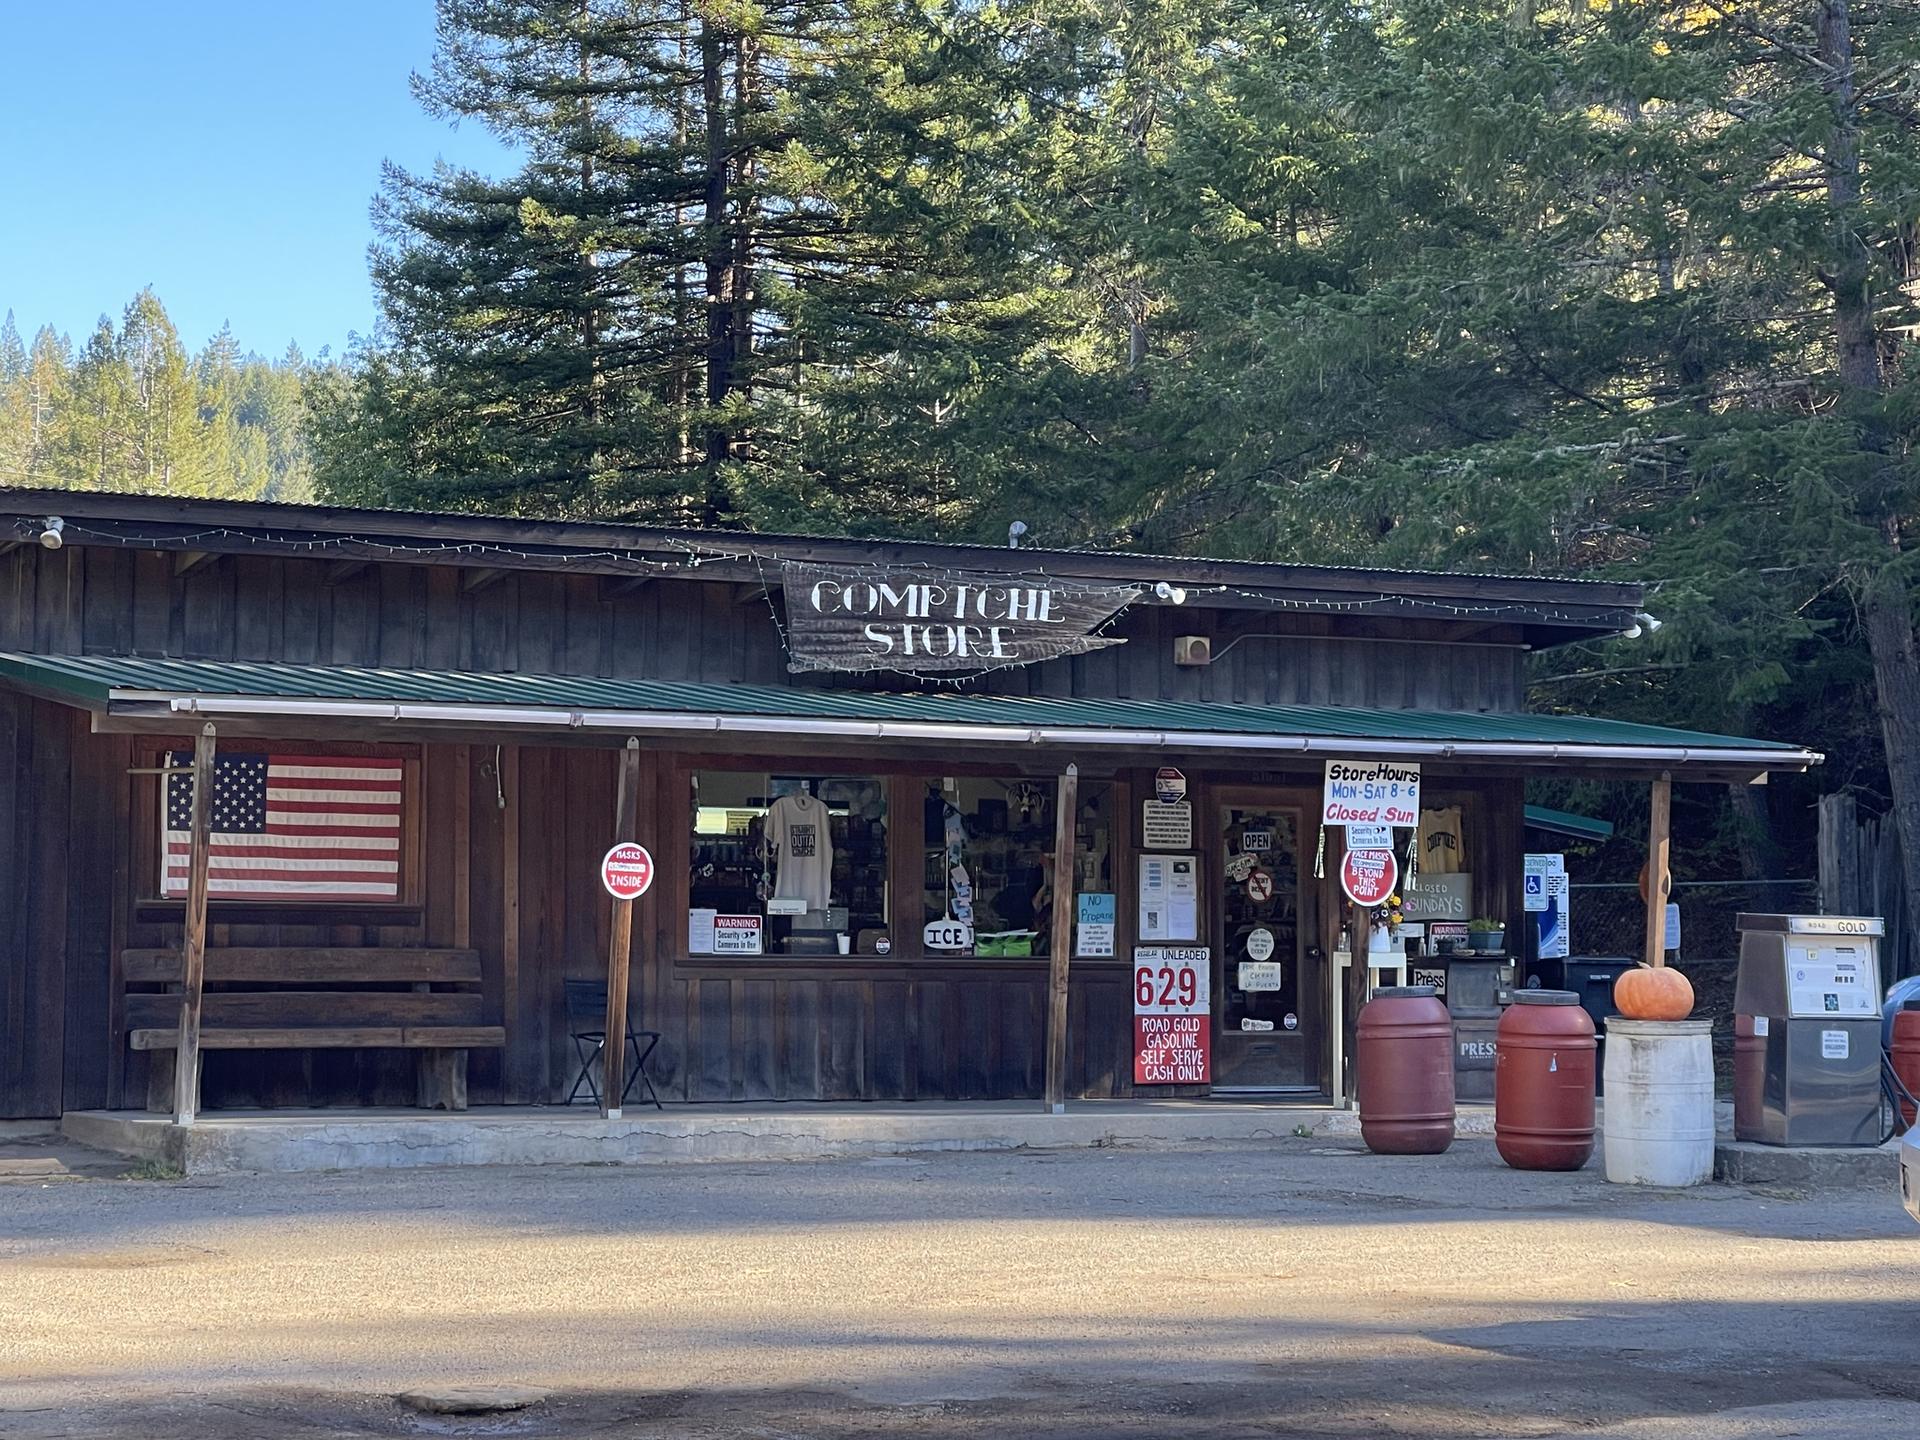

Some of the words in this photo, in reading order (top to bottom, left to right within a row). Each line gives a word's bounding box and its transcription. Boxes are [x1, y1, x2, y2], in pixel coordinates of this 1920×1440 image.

[811, 580, 1065, 623] COMPTCHE
[864, 623, 1020, 659] STORE
[1329, 764, 1377, 781] Store
[1375, 763, 1420, 783] Hours
[1326, 803, 1380, 822] Closed
[1384, 807, 1415, 823] Sun
[1351, 826, 1372, 836] Security
[791, 835, 815, 847] OUTTA
[1245, 834, 1269, 848] OPEN
[616, 850, 641, 860] MASKS
[1369, 851, 1390, 861] MASKS
[1352, 867, 1384, 879] BEYOND
[610, 875, 643, 888] INSIDE
[1358, 877, 1376, 888] THIS
[1353, 886, 1380, 897] POINT
[1087, 895, 1102, 906] NO
[1409, 896, 1463, 914] SUNDAYS
[717, 919, 758, 928] WARNING
[1838, 921, 1867, 933] GOLD
[717, 930, 740, 940] Security
[927, 928, 964, 945] ICE
[1434, 926, 1468, 935] WARNING
[717, 941, 739, 949] Cameras
[1162, 950, 1207, 960] UNLEADED
[1415, 971, 1445, 988] Press
[1136, 967, 1197, 1006] 629
[1142, 1018, 1170, 1032] ROAD
[1173, 1018, 1200, 1032] GOLD
[1146, 1033, 1198, 1049] GASOLINE
[1140, 1049, 1166, 1065] SELF
[1170, 1049, 1204, 1065] SERVE
[1145, 1065, 1174, 1081] CASH
[1177, 1065, 1205, 1081] ONLY
